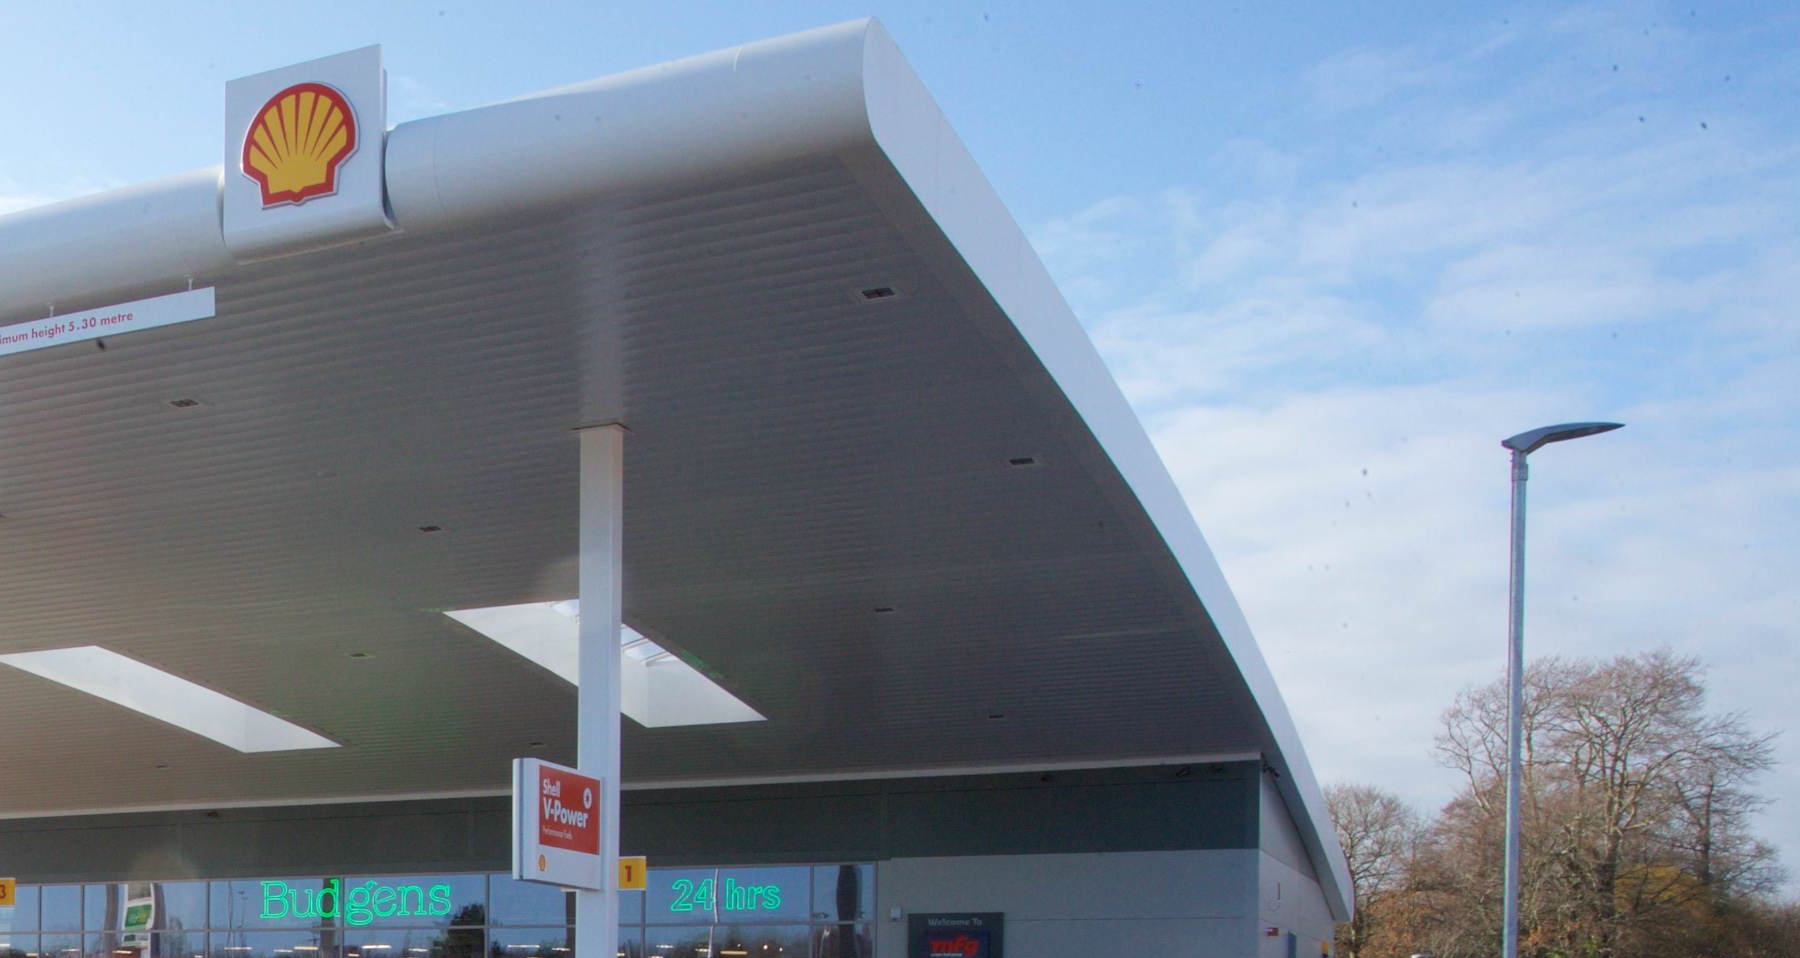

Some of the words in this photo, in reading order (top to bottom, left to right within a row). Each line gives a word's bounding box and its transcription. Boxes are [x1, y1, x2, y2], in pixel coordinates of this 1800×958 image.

[31, 322, 66, 341] height
[68, 316, 97, 333] 5.30
[100, 311, 134, 326] metre
[542, 778, 561, 797] Shell
[543, 797, 589, 828] V-Power
[625, 865, 632, 882] 1
[259, 878, 451, 926] Budgens
[670, 878, 716, 912] 24
[726, 877, 781, 910] hrs
[927, 918, 969, 926] Welcome
[929, 936, 979, 957] mfg
